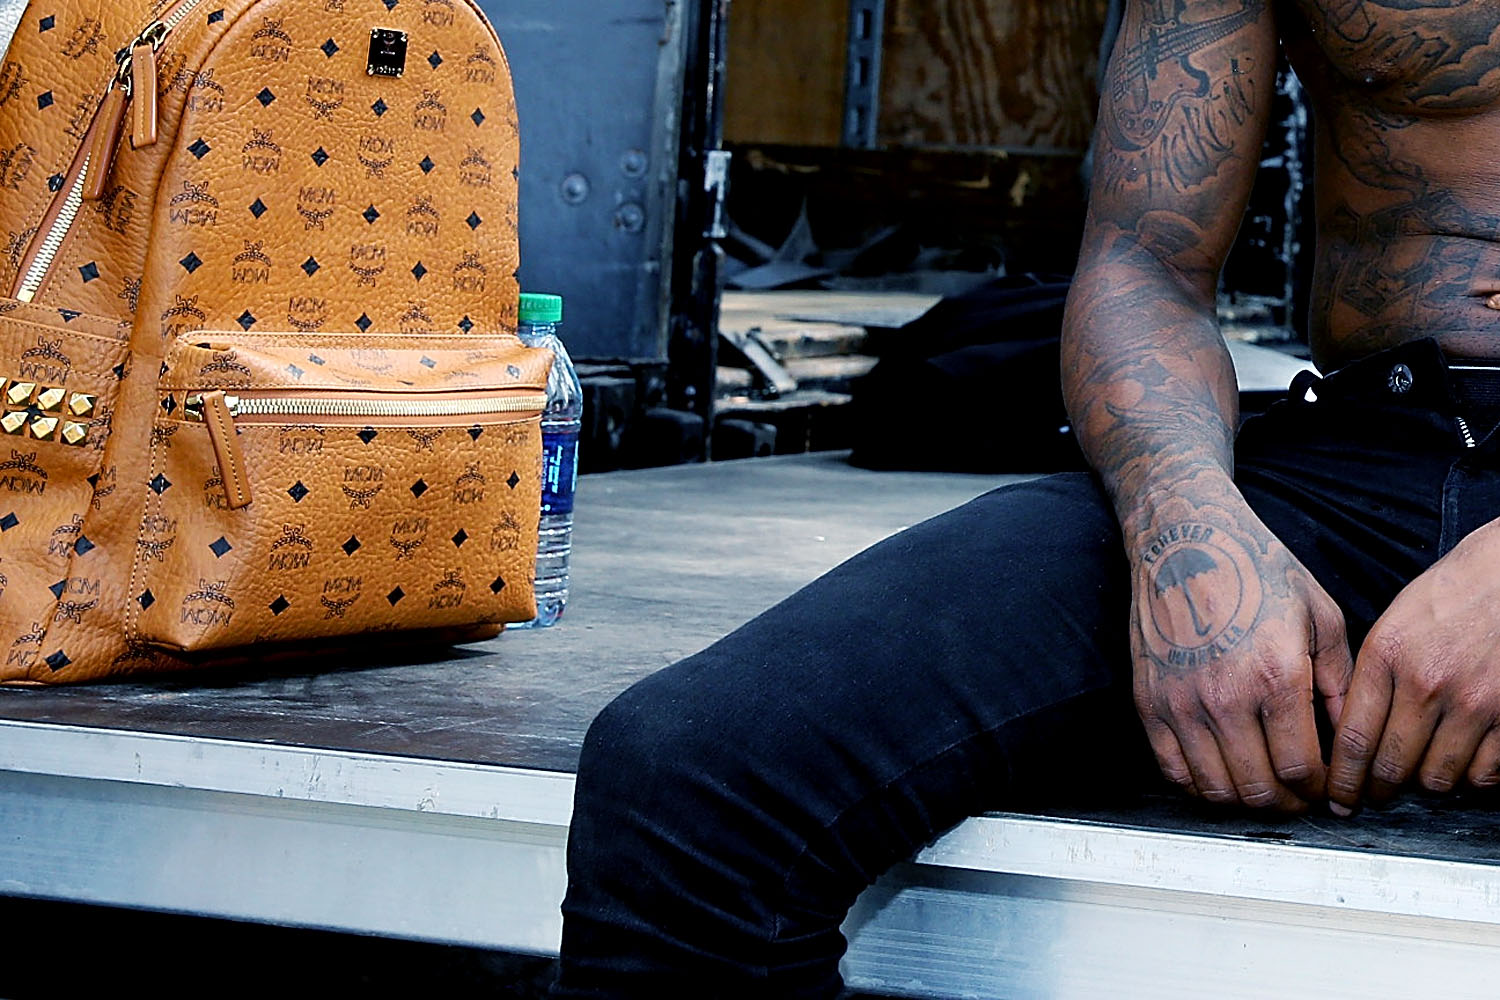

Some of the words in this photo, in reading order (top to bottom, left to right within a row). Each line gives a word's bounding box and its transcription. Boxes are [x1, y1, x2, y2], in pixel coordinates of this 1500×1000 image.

[251, 45, 290, 61] MCM
[308, 77, 345, 94] MCM
[358, 135, 394, 153] MCM
[242, 156, 280, 174] MCM
[300, 187, 335, 203] MCM
[169, 208, 217, 226] MCM
[232, 268, 270, 284] MCM
[288, 297, 326, 313] MCM
[19, 362, 69, 385] MCM
[344, 466, 384, 482] MCM
[392, 519, 429, 534] MCM
[1144, 524, 1214, 564] FOREVER
[269, 552, 310, 571] MCM
[323, 577, 361, 593] MCM
[181, 608, 233, 627] MCM
